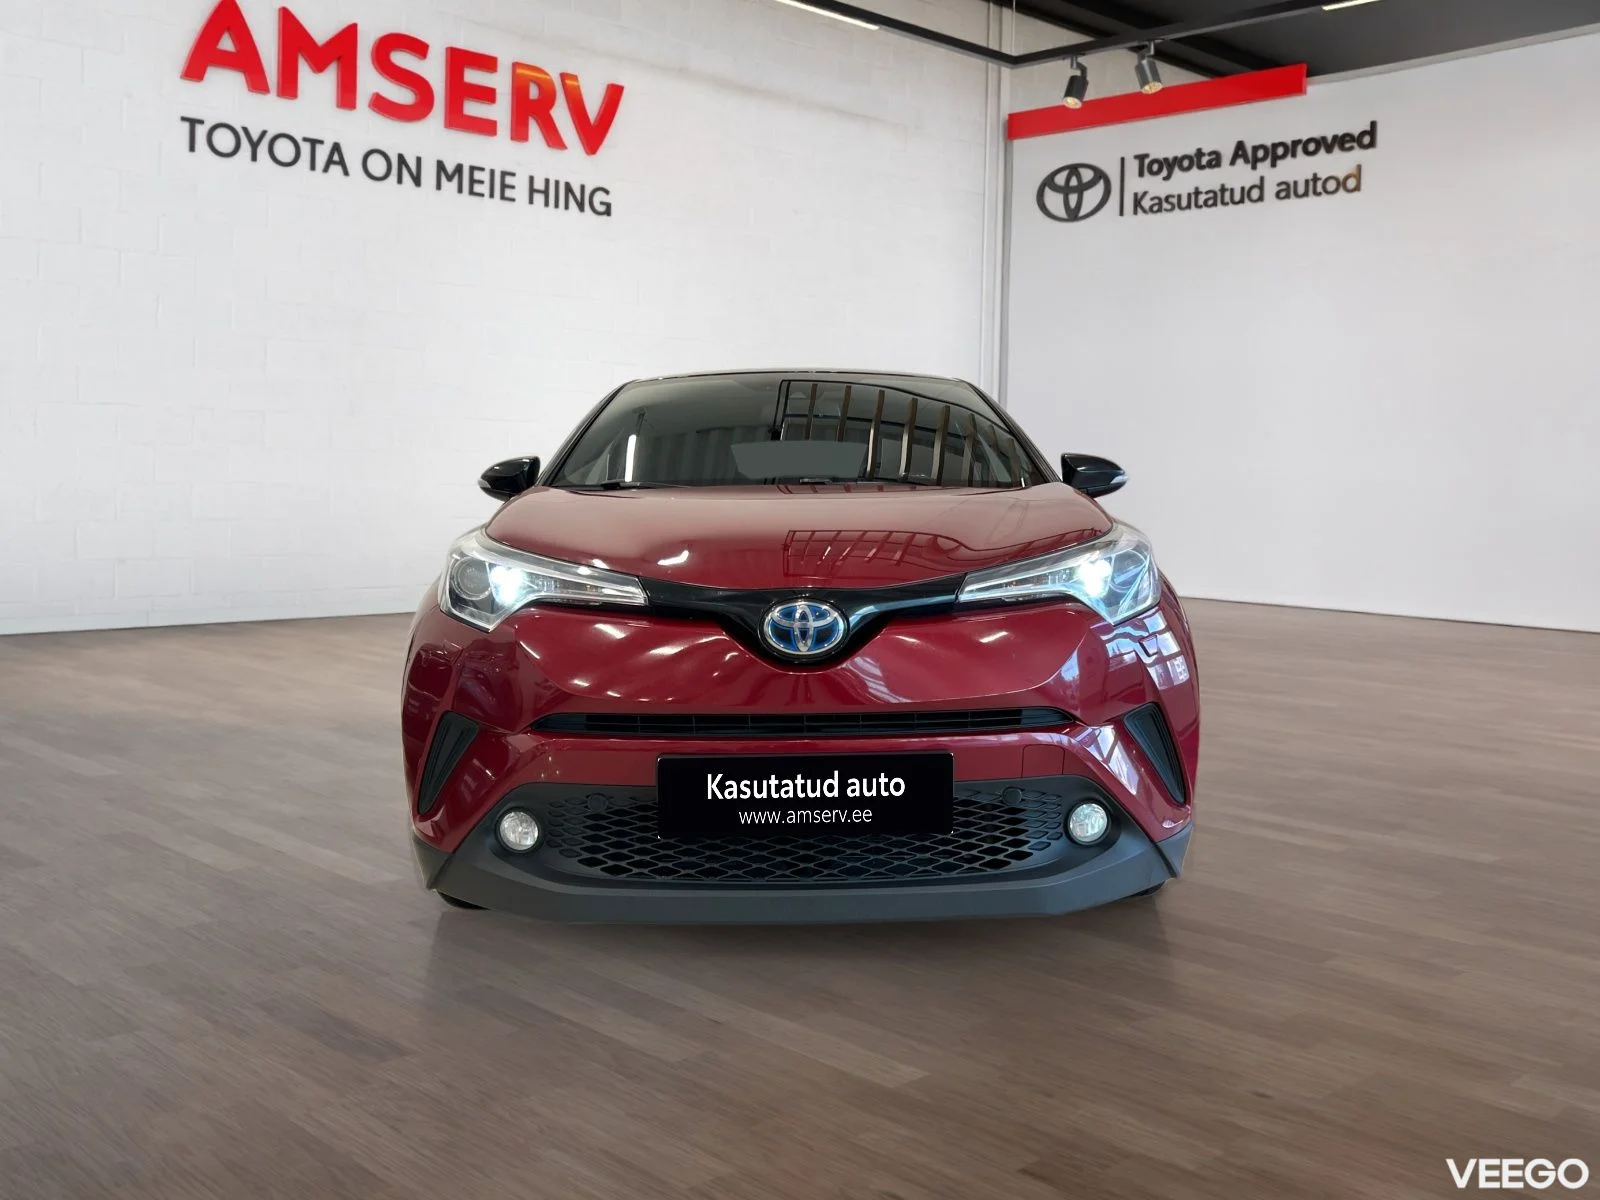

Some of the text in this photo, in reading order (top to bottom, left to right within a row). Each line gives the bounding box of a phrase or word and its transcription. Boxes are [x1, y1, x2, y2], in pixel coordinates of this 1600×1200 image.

[180, 0, 624, 156] AMSERV
[180, 116, 612, 216] TOYOTA ON MEIE HING
[1134, 120, 1378, 181] Toyota Approved
[1133, 164, 1362, 216] Kasutatud autod
[706, 770, 906, 800] Kasutatud auto
[738, 807, 873, 825] www.amserv.ee
